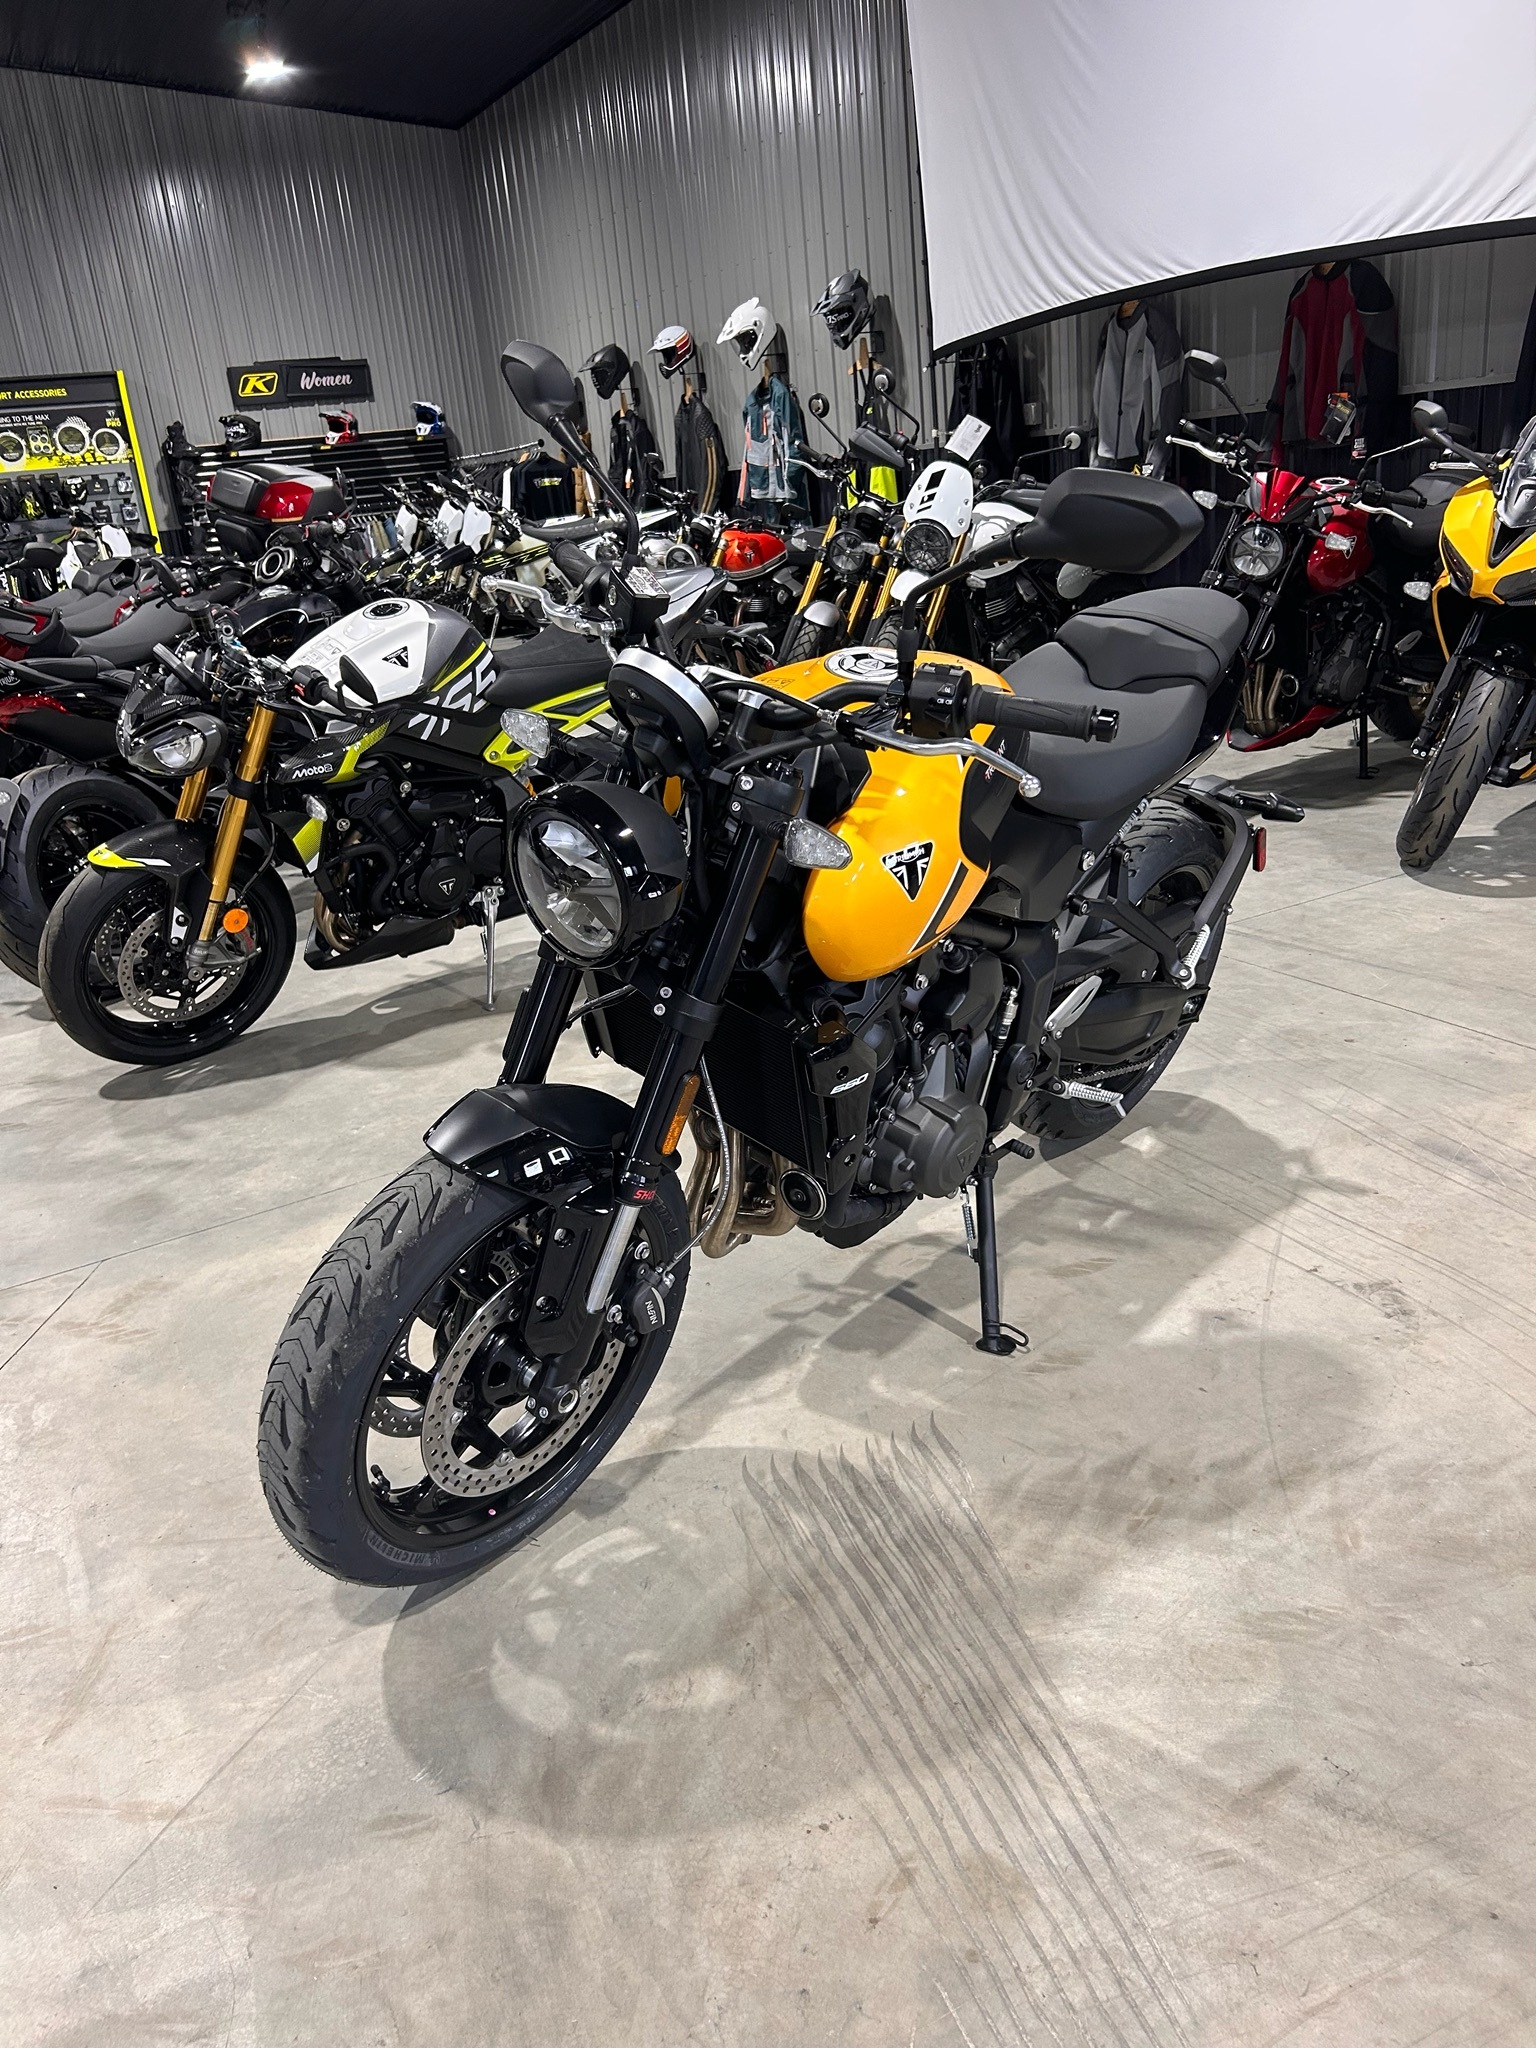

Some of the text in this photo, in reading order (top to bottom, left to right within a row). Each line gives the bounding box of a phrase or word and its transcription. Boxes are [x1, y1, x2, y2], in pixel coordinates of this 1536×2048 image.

[300, 371, 353, 390] Women
[14, 388, 68, 399] ACCESSORIES
[21, 414, 34, 422] THE
[35, 413, 50, 421] MAX
[291, 763, 334, 780] Moto2
[829, 1072, 870, 1095] 660
[368, 1534, 427, 1566] MICHELIN
